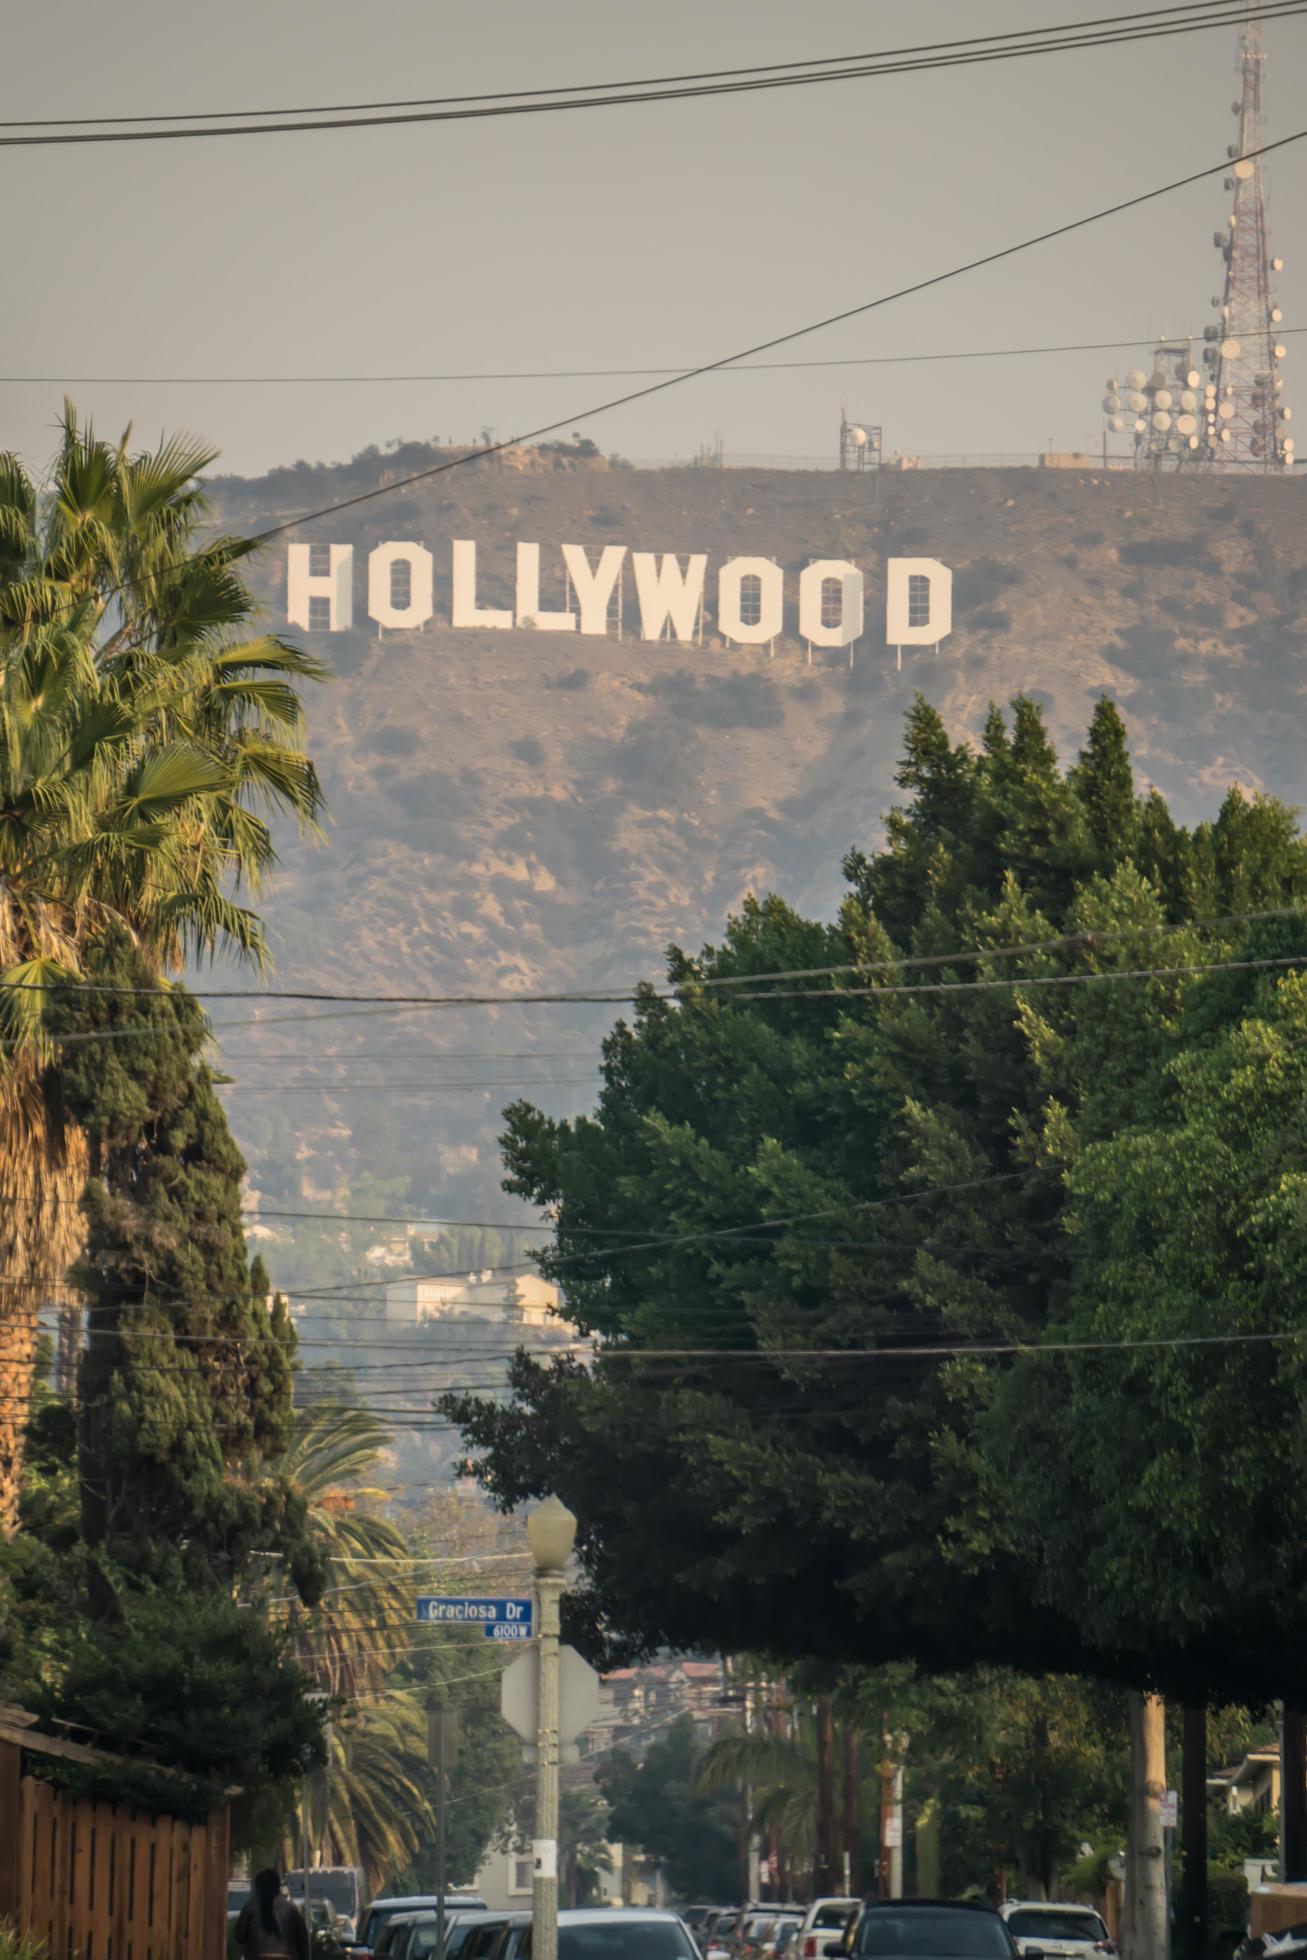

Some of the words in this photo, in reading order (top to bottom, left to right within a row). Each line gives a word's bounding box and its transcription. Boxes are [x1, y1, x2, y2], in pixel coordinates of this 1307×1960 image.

[287, 540, 952, 647] HOLLYWOOD
[428, 1601, 497, 1619] Graciosa
[506, 1602, 524, 1619] Dr
